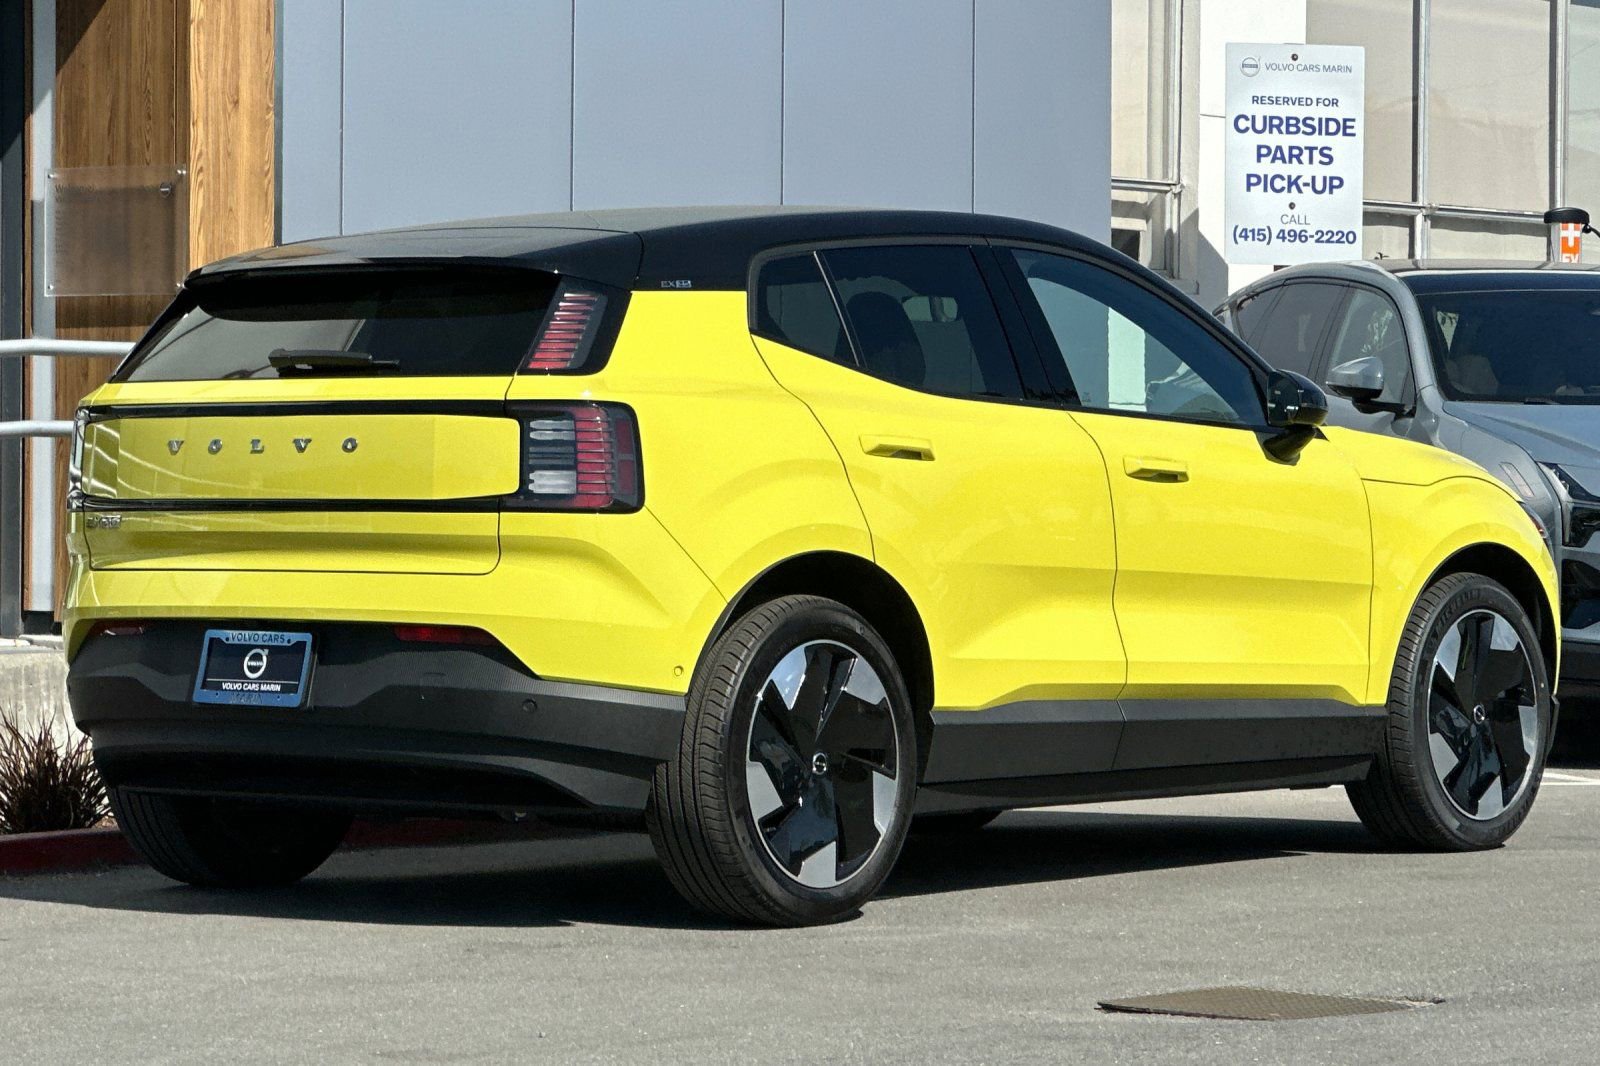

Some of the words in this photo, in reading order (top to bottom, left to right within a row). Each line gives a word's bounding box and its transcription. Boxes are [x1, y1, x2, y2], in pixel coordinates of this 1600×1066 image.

[1265, 63, 1294, 72] VOLVO
[1296, 64, 1320, 72] CARS
[1323, 65, 1352, 73] MARIN
[1252, 96, 1313, 106] RESERVED
[1316, 98, 1339, 107] FOR
[1233, 114, 1356, 137] CURBSIDE
[1256, 144, 1334, 166] PARTS
[1246, 173, 1344, 195] PICK-UP
[1280, 214, 1310, 225] CALL
[1233, 225, 1272, 245] (415)
[1276, 229, 1357, 244] 496-2220
[167, 437, 358, 455] VOLVO
[230, 633, 260, 642] VOLVO
[261, 634, 285, 643] CARS
[222, 682, 242, 690] VOLVO
[243, 683, 260, 691] CARS
[260, 684, 281, 692] MARIN
